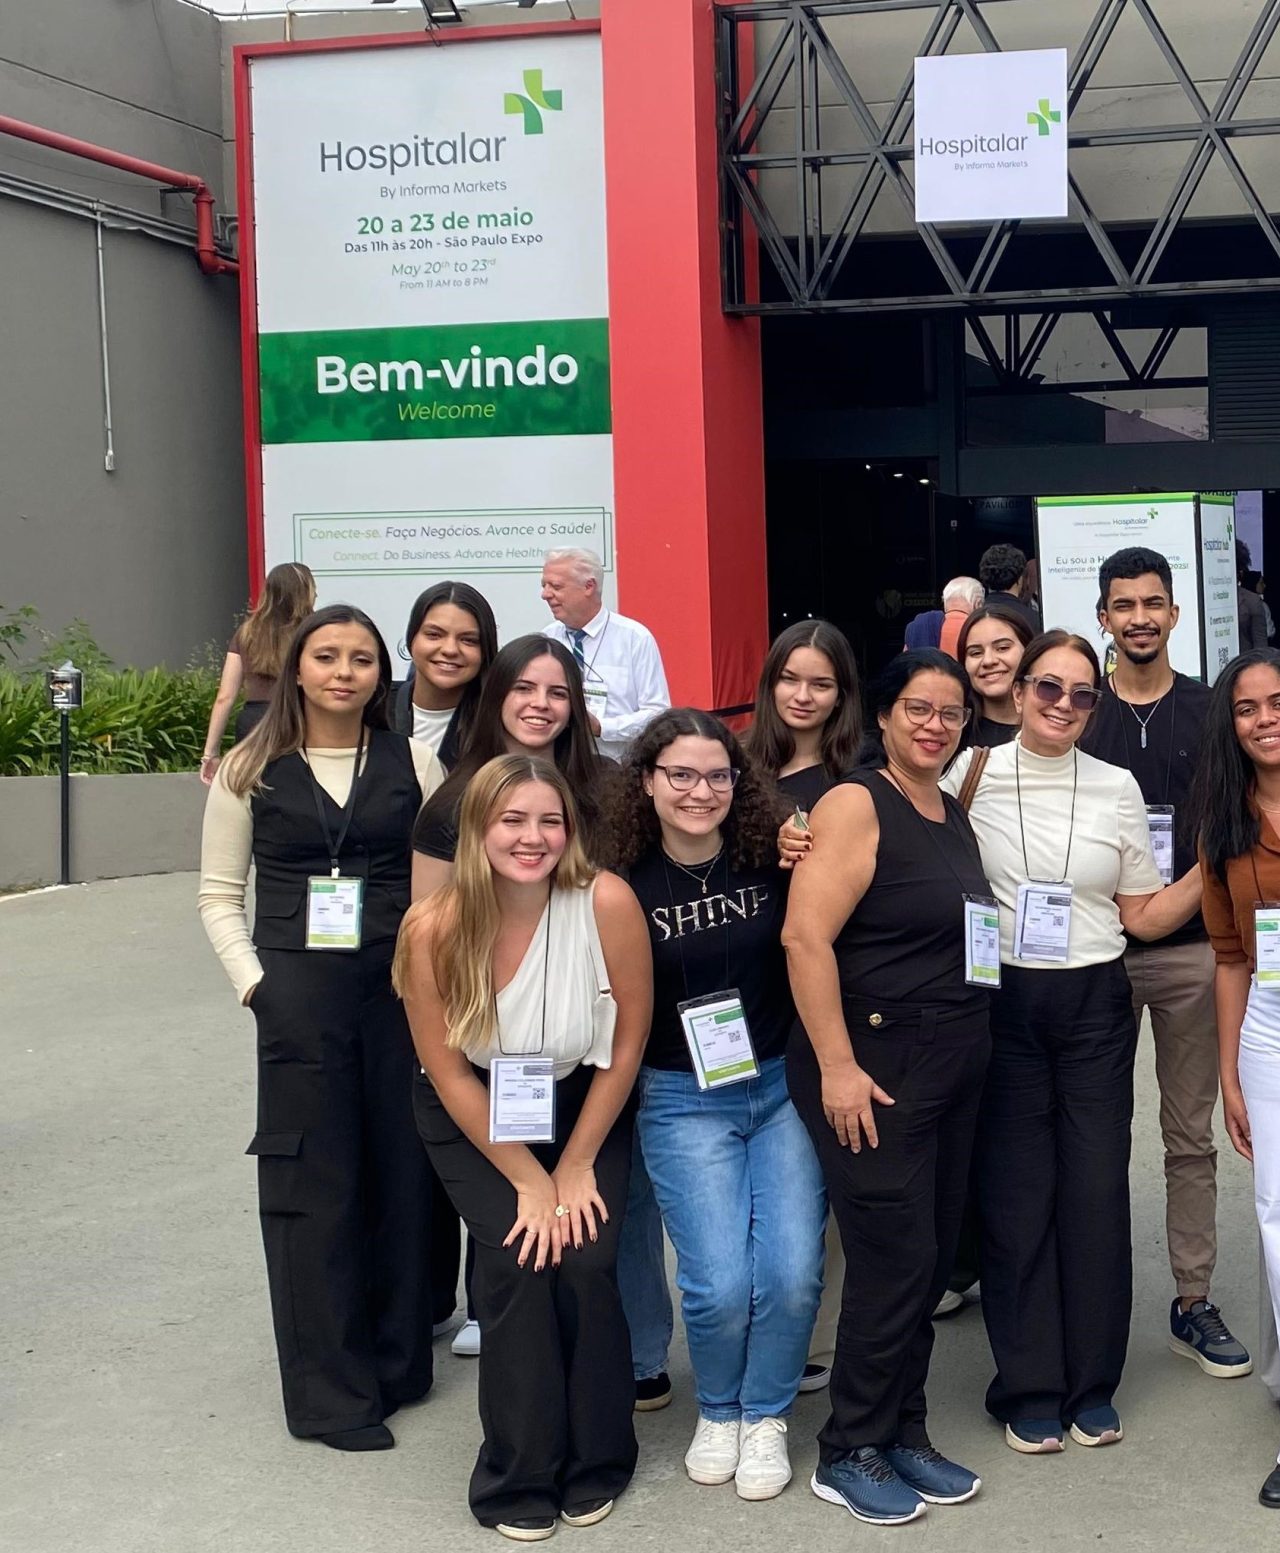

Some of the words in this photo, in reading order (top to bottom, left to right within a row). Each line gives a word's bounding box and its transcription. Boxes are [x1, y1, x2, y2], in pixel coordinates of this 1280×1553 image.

[320, 132, 507, 175] Hospitalar
[920, 133, 1028, 158] Hospitalar
[954, 163, 964, 171] By
[966, 161, 995, 170] Informa
[997, 159, 1028, 168] Markets
[380, 187, 396, 199] By
[399, 183, 450, 196] Informa
[453, 180, 507, 194] Markets
[357, 216, 384, 235] 20
[391, 219, 402, 233] a
[410, 213, 435, 232] 23
[442, 211, 469, 230] de
[477, 207, 533, 228] maio
[344, 242, 368, 253] Das
[370, 241, 388, 252] 11h
[392, 239, 406, 251] às
[409, 238, 433, 250] 20h
[444, 236, 468, 248] São
[471, 233, 507, 247] Paulo
[511, 233, 543, 247] Expo
[391, 263, 421, 277] May
[454, 260, 468, 272] to
[400, 280, 424, 289] From
[435, 279, 450, 288] AM
[453, 279, 463, 287] to
[473, 277, 489, 286] PM
[316, 345, 578, 394] Bem-vindo
[398, 402, 496, 421] Welcome
[385, 526, 417, 541] Faça
[420, 524, 482, 540] Negócios.
[485, 524, 535, 536] Avance
[537, 526, 546, 535] a
[550, 522, 596, 535] Saúde!
[383, 550, 399, 560] Do
[454, 548, 503, 559] Advance
[506, 547, 546, 559] Health
[1056, 556, 1068, 565] Eu
[1070, 556, 1087, 565] sou
